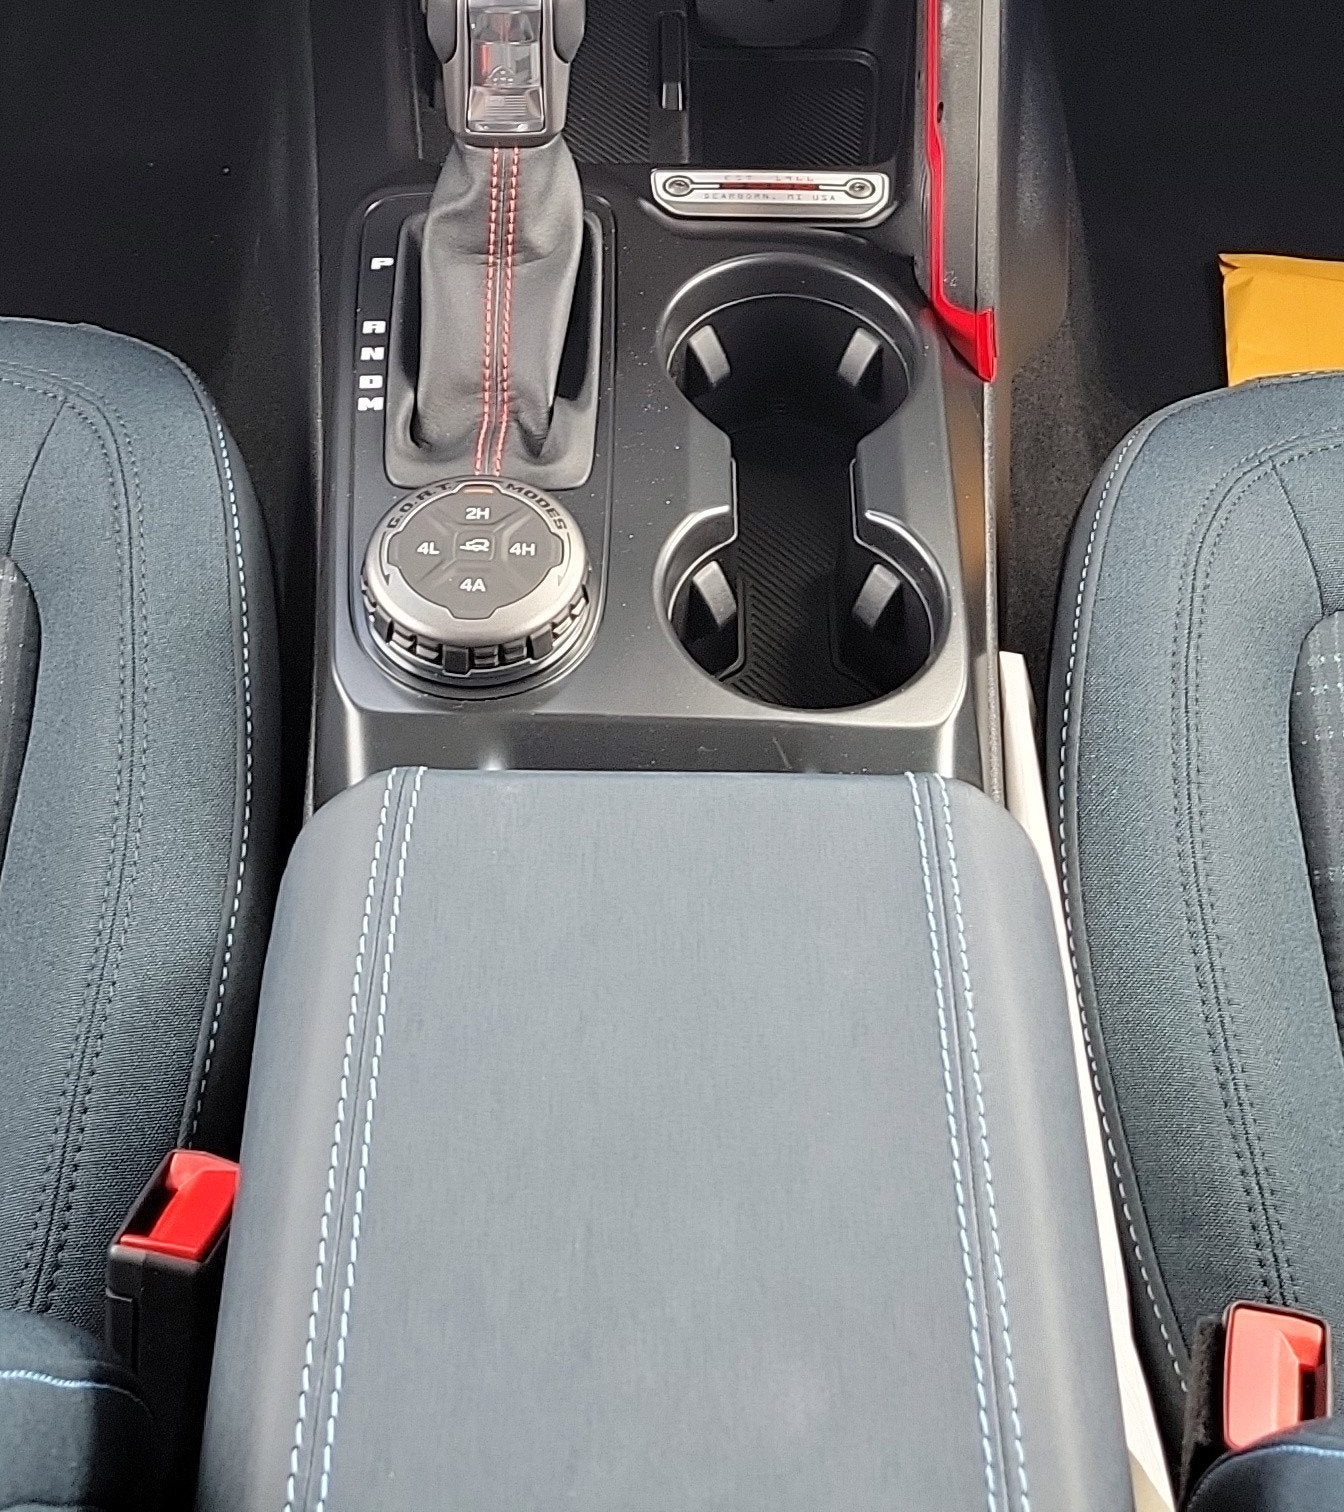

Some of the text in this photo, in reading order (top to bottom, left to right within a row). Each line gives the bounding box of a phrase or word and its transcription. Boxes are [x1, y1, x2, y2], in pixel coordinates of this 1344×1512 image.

[370, 257, 395, 270] P
[360, 347, 384, 360] N
[358, 397, 384, 411] M
[507, 482, 568, 530] MODES
[465, 507, 490, 520] 2H
[416, 541, 440, 555] 4L
[509, 542, 536, 556] 4H
[459, 578, 486, 592] 4A
